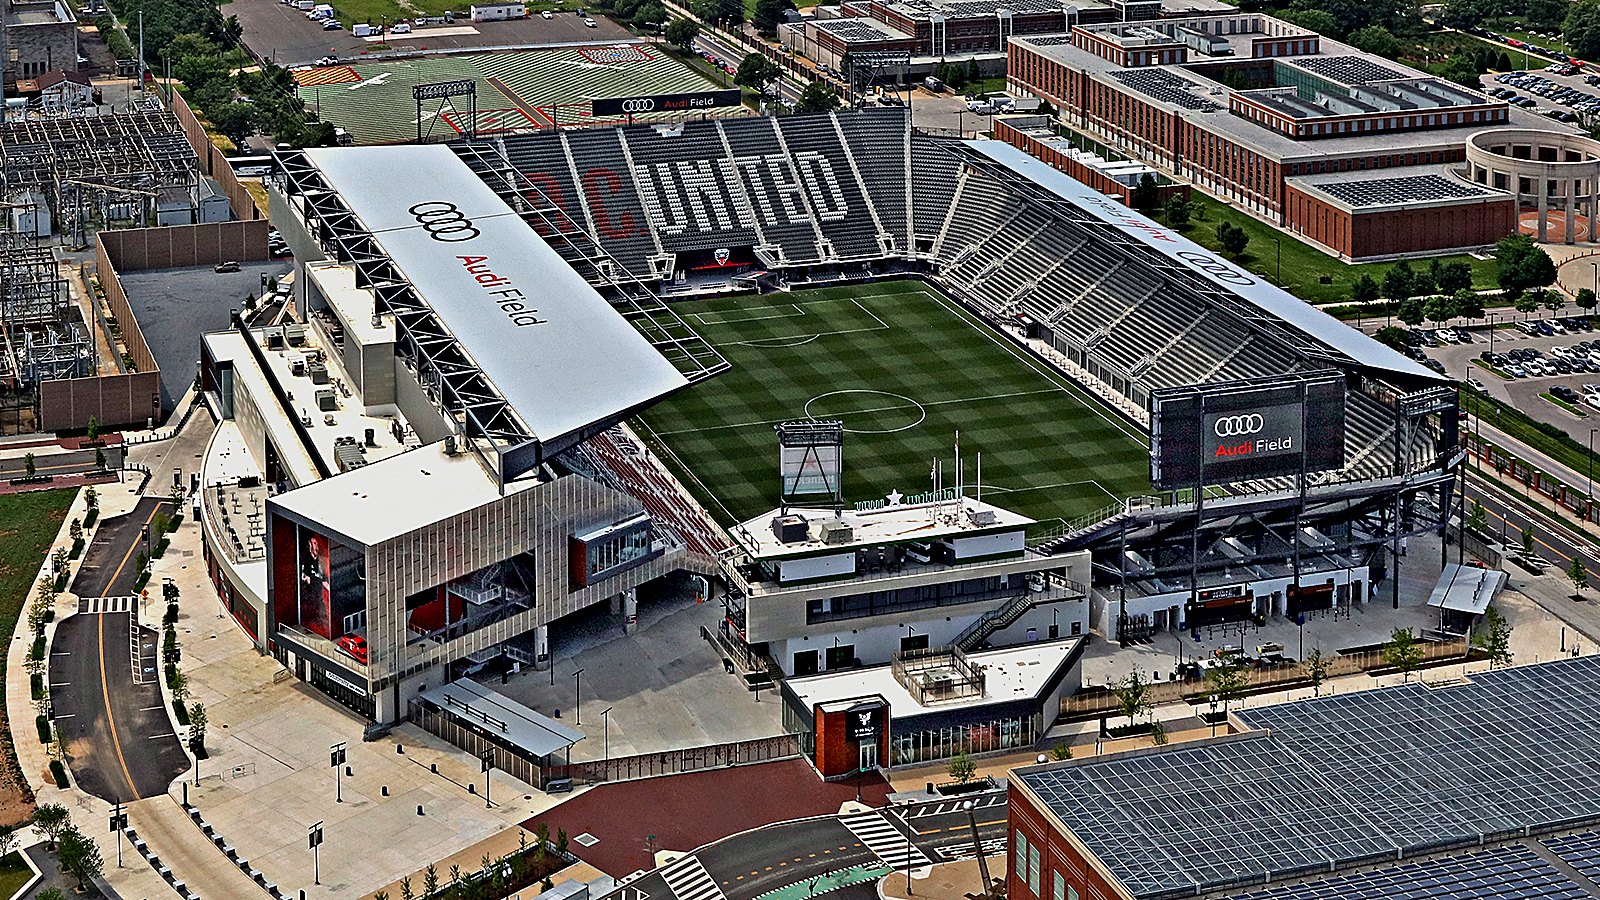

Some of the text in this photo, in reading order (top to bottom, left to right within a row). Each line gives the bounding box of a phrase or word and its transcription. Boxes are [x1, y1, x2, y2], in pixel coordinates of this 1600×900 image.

[690, 98, 714, 106] Field
[635, 150, 849, 236] UNITED
[1079, 196, 1177, 242] Audi Field
[455, 255, 548, 327] Audi Field
[1215, 436, 1292, 458] Audi Field
